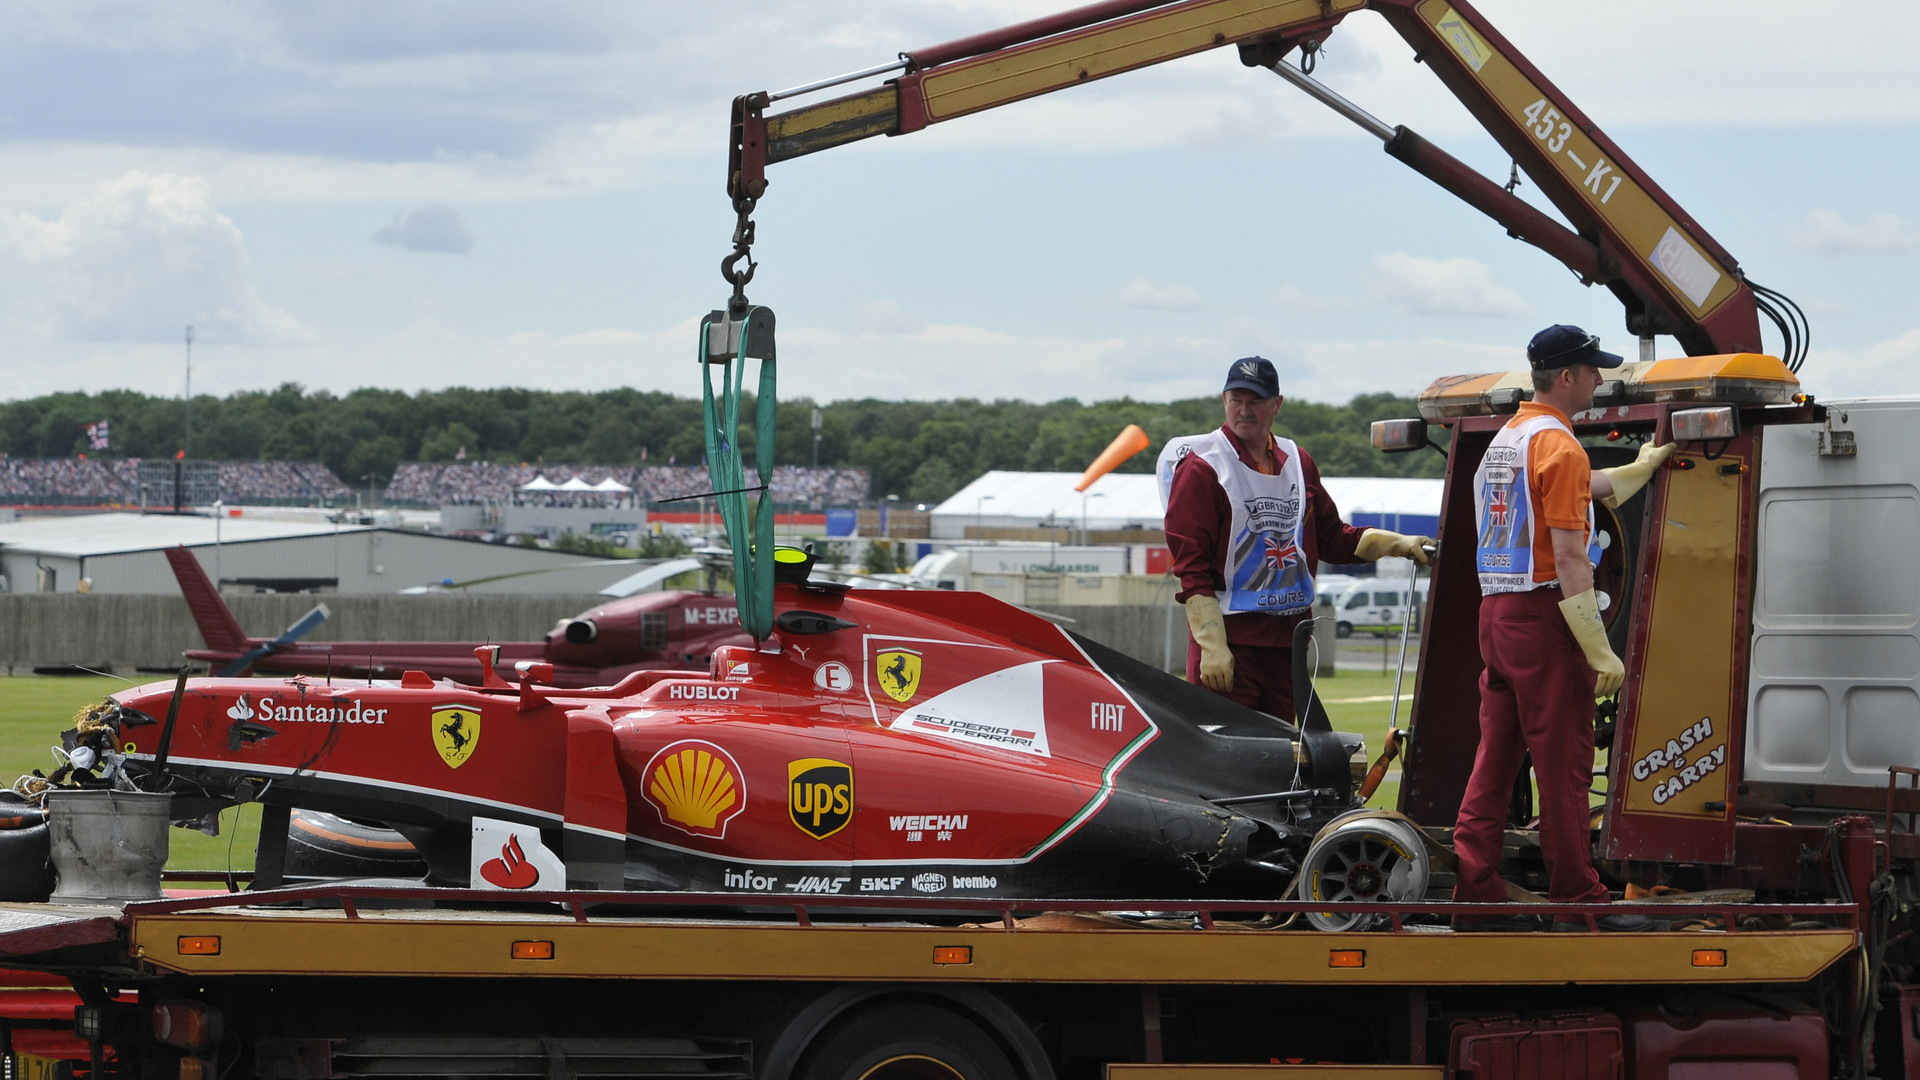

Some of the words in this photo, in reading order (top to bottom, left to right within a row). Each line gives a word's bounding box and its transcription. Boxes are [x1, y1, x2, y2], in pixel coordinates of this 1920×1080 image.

[1257, 591, 1306, 607] COURS
[684, 606, 739, 625] M-EXP
[825, 665, 842, 689] E
[670, 685, 740, 700] HUBLOT
[258, 697, 388, 725] Santander
[1091, 701, 1126, 732] FIAT
[915, 714, 1009, 735] SCUDERIA
[951, 727, 1033, 747] FERRARI
[1633, 717, 1713, 780] CRASH
[1674, 757, 1686, 769] &
[1652, 744, 1725, 804] CARRY
[793, 782, 850, 827] ups
[889, 815, 968, 831] WEICHAI
[724, 868, 778, 891] infor
[785, 876, 851, 894] HAAS
[860, 877, 905, 891] SKF
[952, 875, 997, 889] brembo
